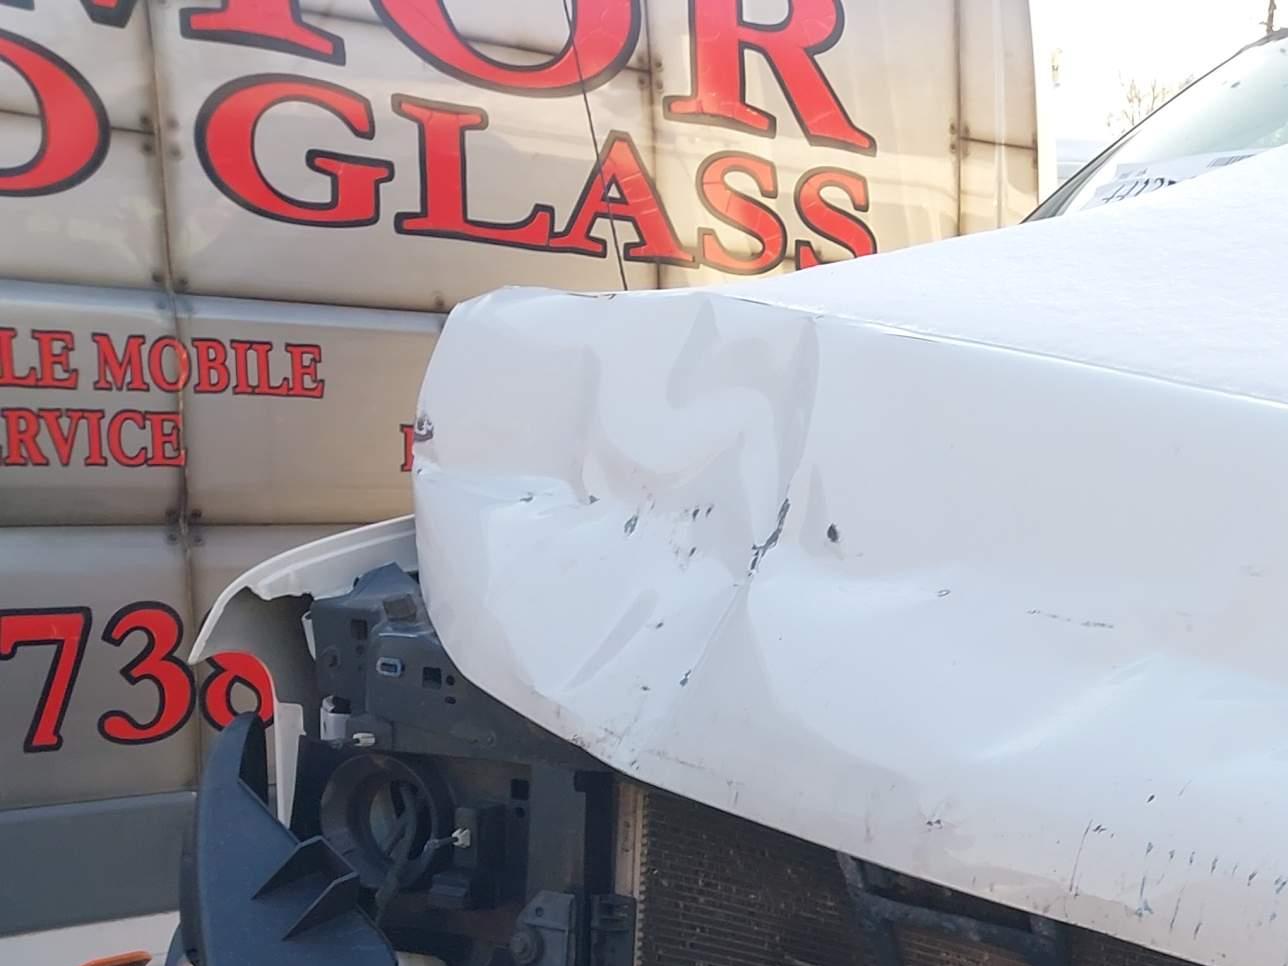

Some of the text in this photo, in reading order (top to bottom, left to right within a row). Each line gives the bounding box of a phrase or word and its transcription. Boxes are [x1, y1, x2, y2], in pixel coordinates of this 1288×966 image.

[194, 73, 877, 274] GLASS
[91, 332, 325, 399] MOBILE
[0, 407, 186, 467] RVICE
